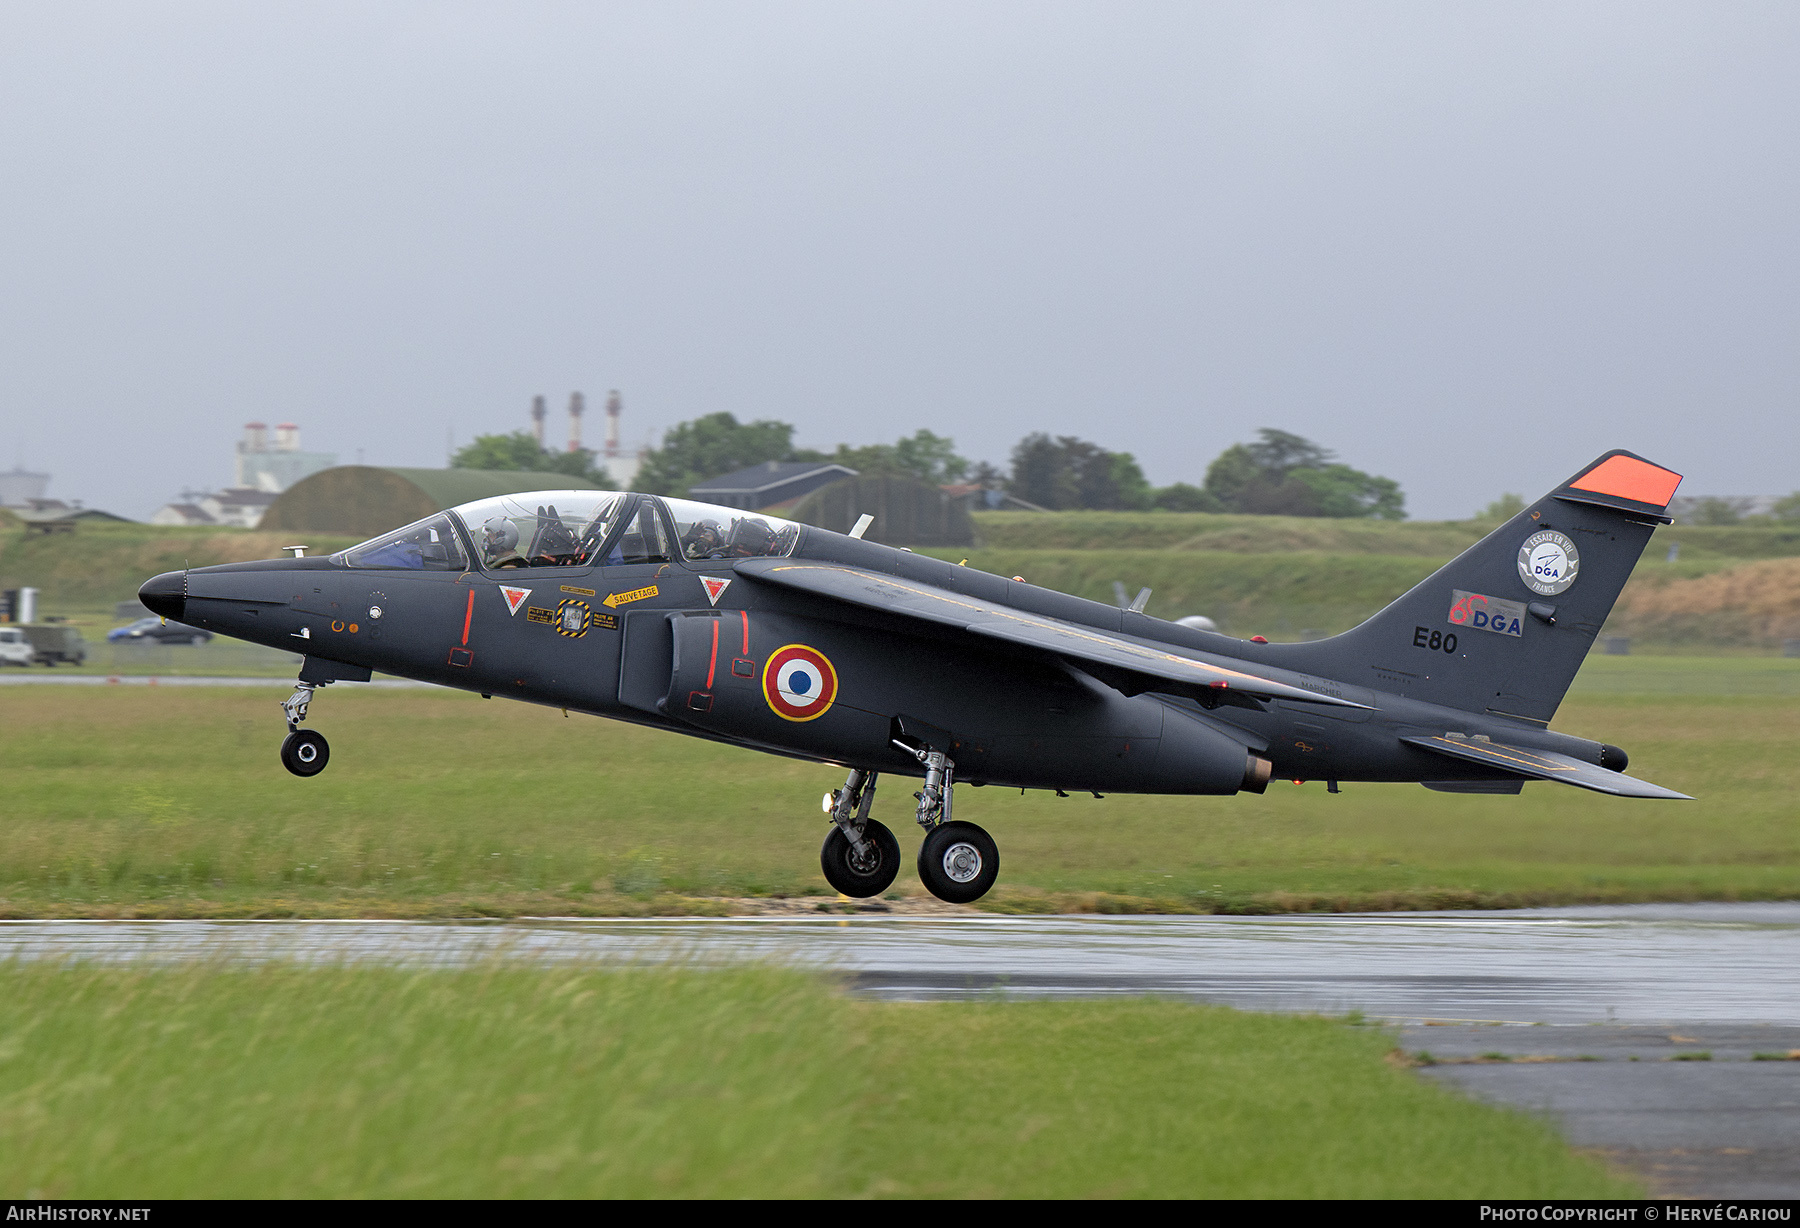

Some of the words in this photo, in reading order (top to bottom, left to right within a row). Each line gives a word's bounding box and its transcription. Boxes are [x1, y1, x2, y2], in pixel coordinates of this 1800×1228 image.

[1530, 532, 1553, 547] ESSAIS
[1554, 534, 1563, 545] EN
[1563, 540, 1574, 554] VOL
[1535, 565, 1559, 578] DGA
[614, 588, 656, 603] SAUVETAGE
[1532, 581, 1555, 593] FRANCE
[1473, 610, 1521, 636] DGA
[1413, 626, 1458, 654] E80
[1301, 681, 1342, 699] MARCHER
